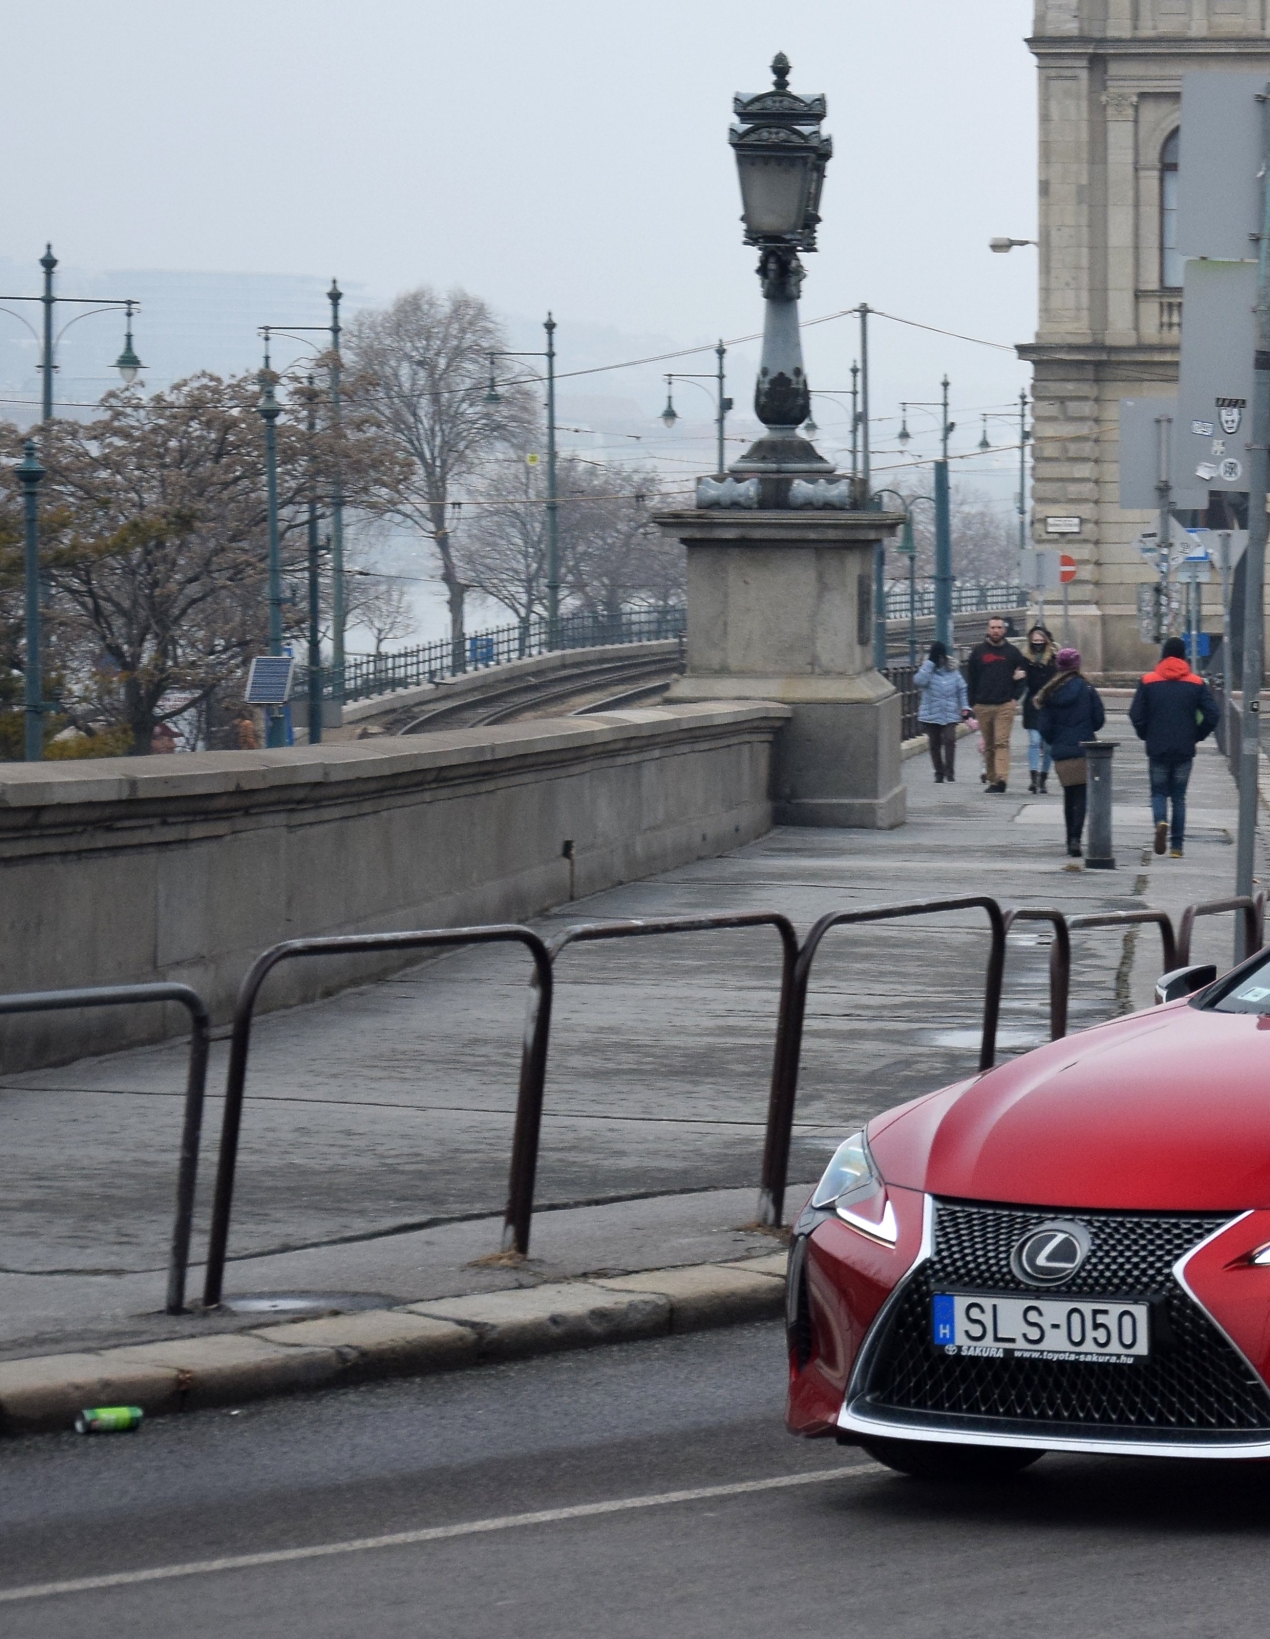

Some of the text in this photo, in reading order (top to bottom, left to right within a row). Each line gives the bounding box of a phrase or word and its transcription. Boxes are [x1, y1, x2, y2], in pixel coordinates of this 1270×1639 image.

[939, 1324, 950, 1339] H
[964, 1302, 1137, 1349] SLS-050
[960, 1345, 1134, 1364] SAKURA www.toyota-sakura.hu
